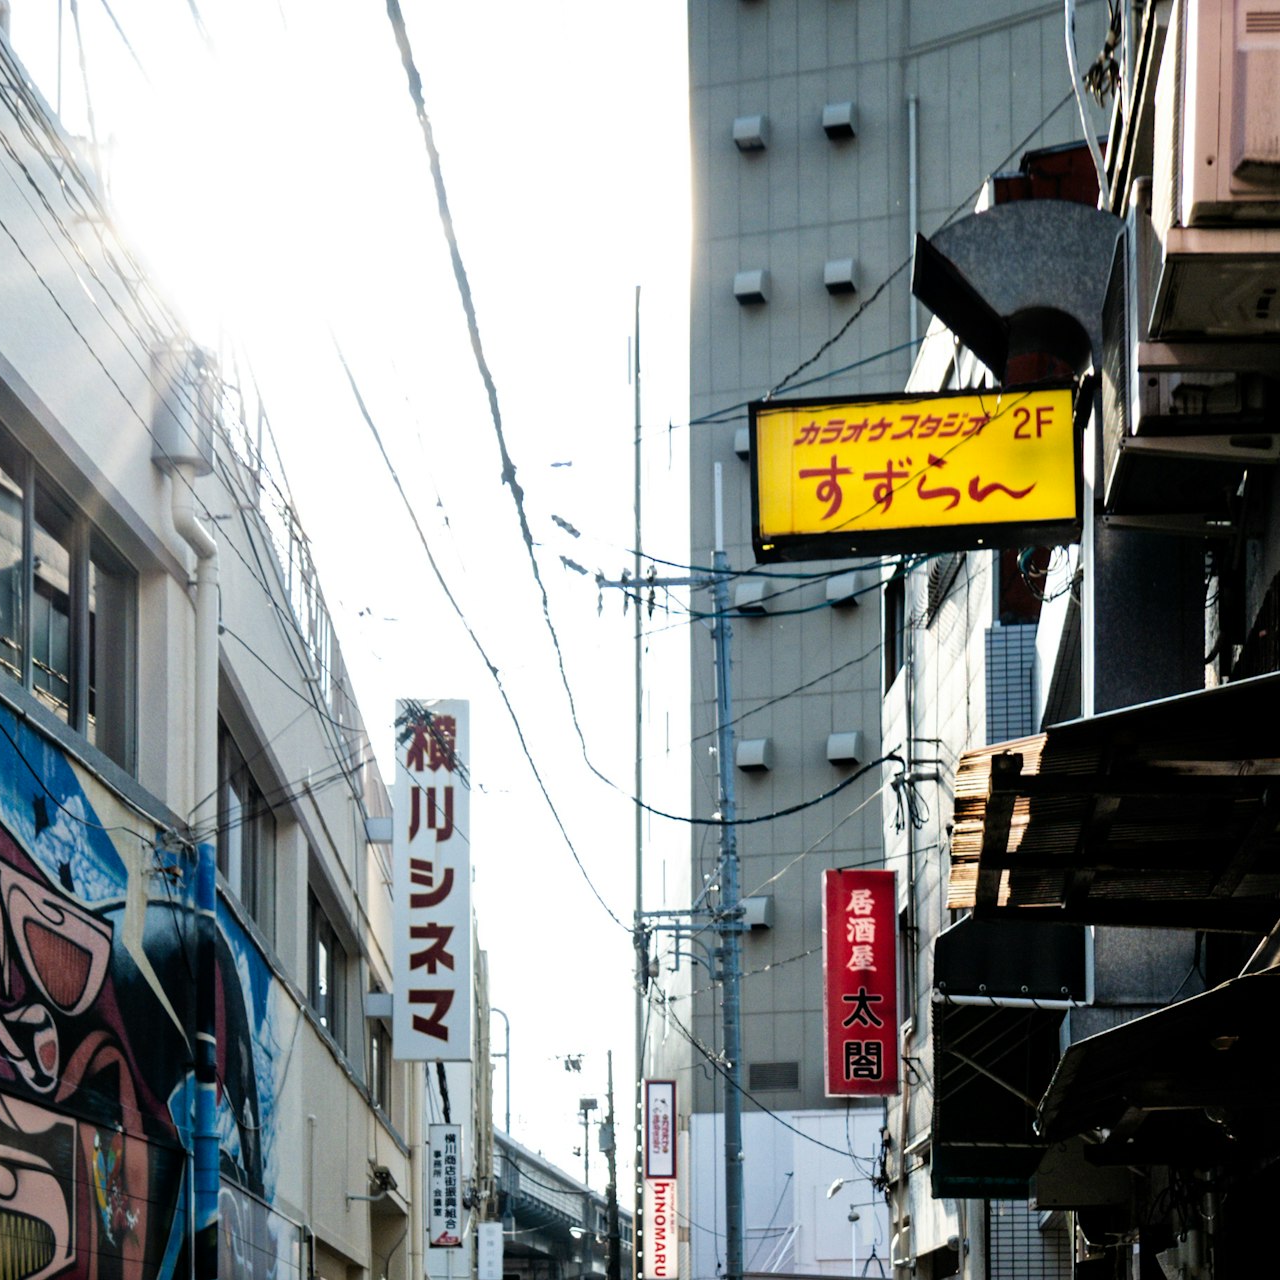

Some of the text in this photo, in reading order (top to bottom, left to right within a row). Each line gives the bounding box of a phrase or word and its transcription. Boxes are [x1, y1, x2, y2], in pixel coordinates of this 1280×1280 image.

[794, 406, 1053, 446] カラオケスタジオ 2F
[798, 453, 1038, 521] すずらん
[406, 713, 456, 1043] 横川シネマ
[845, 888, 878, 973] 居酒屋
[842, 985, 884, 1082] 太閤
